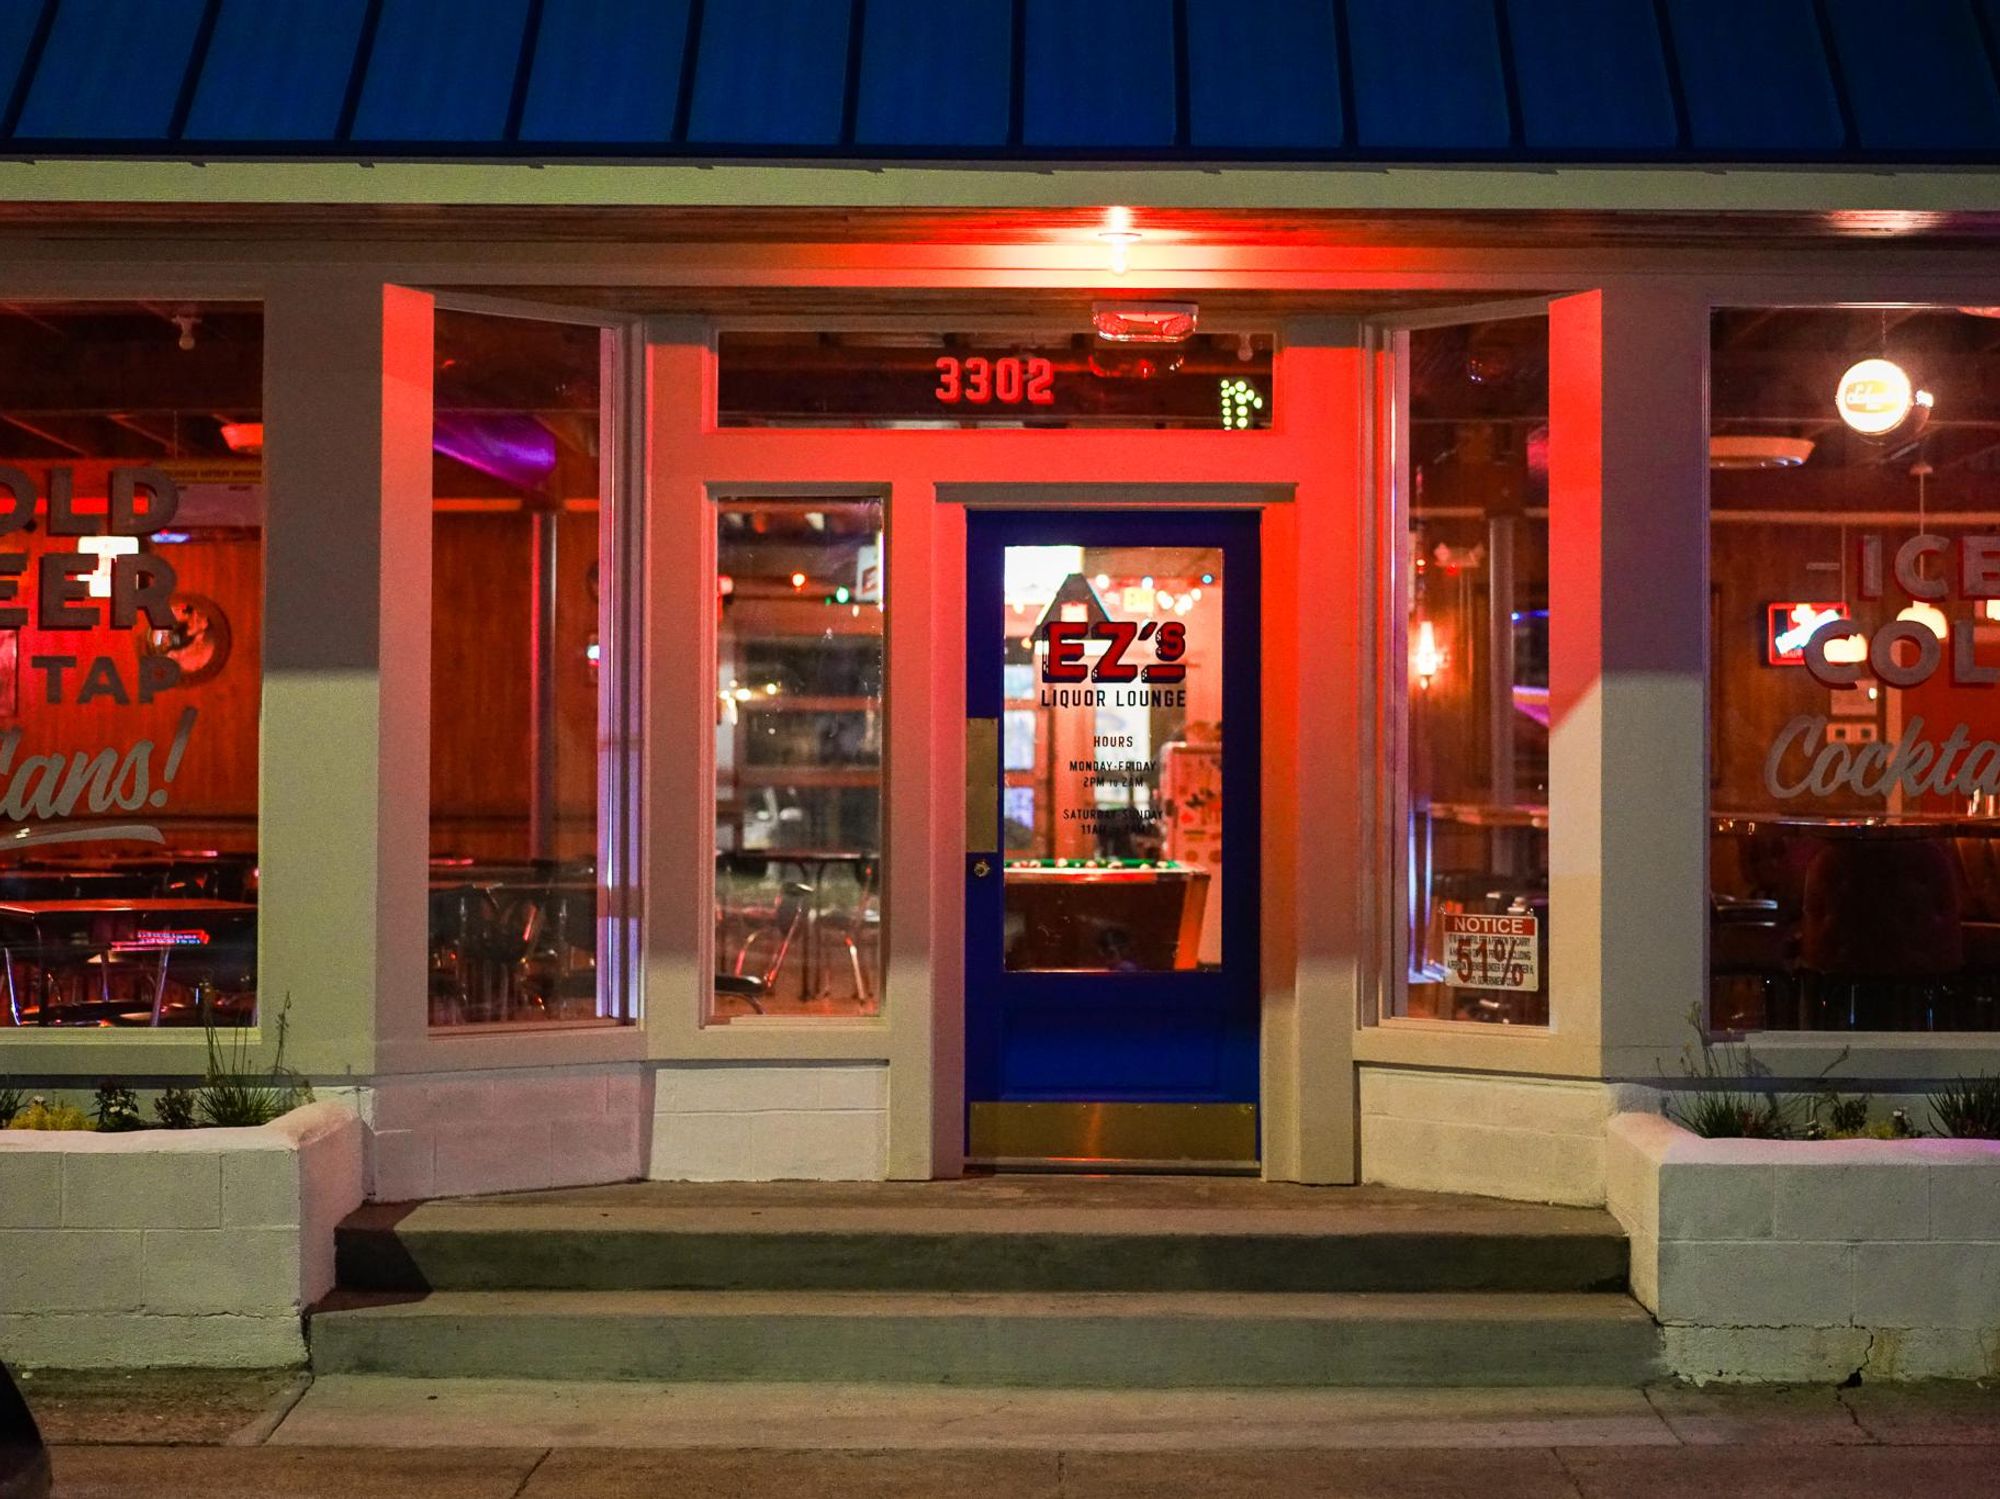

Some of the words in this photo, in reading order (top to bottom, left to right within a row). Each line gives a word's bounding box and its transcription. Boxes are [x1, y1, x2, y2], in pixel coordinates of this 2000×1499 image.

[936, 357, 1053, 404] 3302
[1860, 534, 2000, 600] ICE
[1804, 618, 2000, 690] COL
[31, 656, 181, 704] TAP
[1041, 689, 1106, 708] LIQUOR
[1116, 689, 1186, 707] LOUNGE
[0, 706, 198, 822] ans!
[1093, 736, 1133, 747] HOURS
[1083, 776, 1104, 788] 2PM
[1454, 917, 1524, 934] NOTICE
[1457, 938, 1524, 987] 51%
